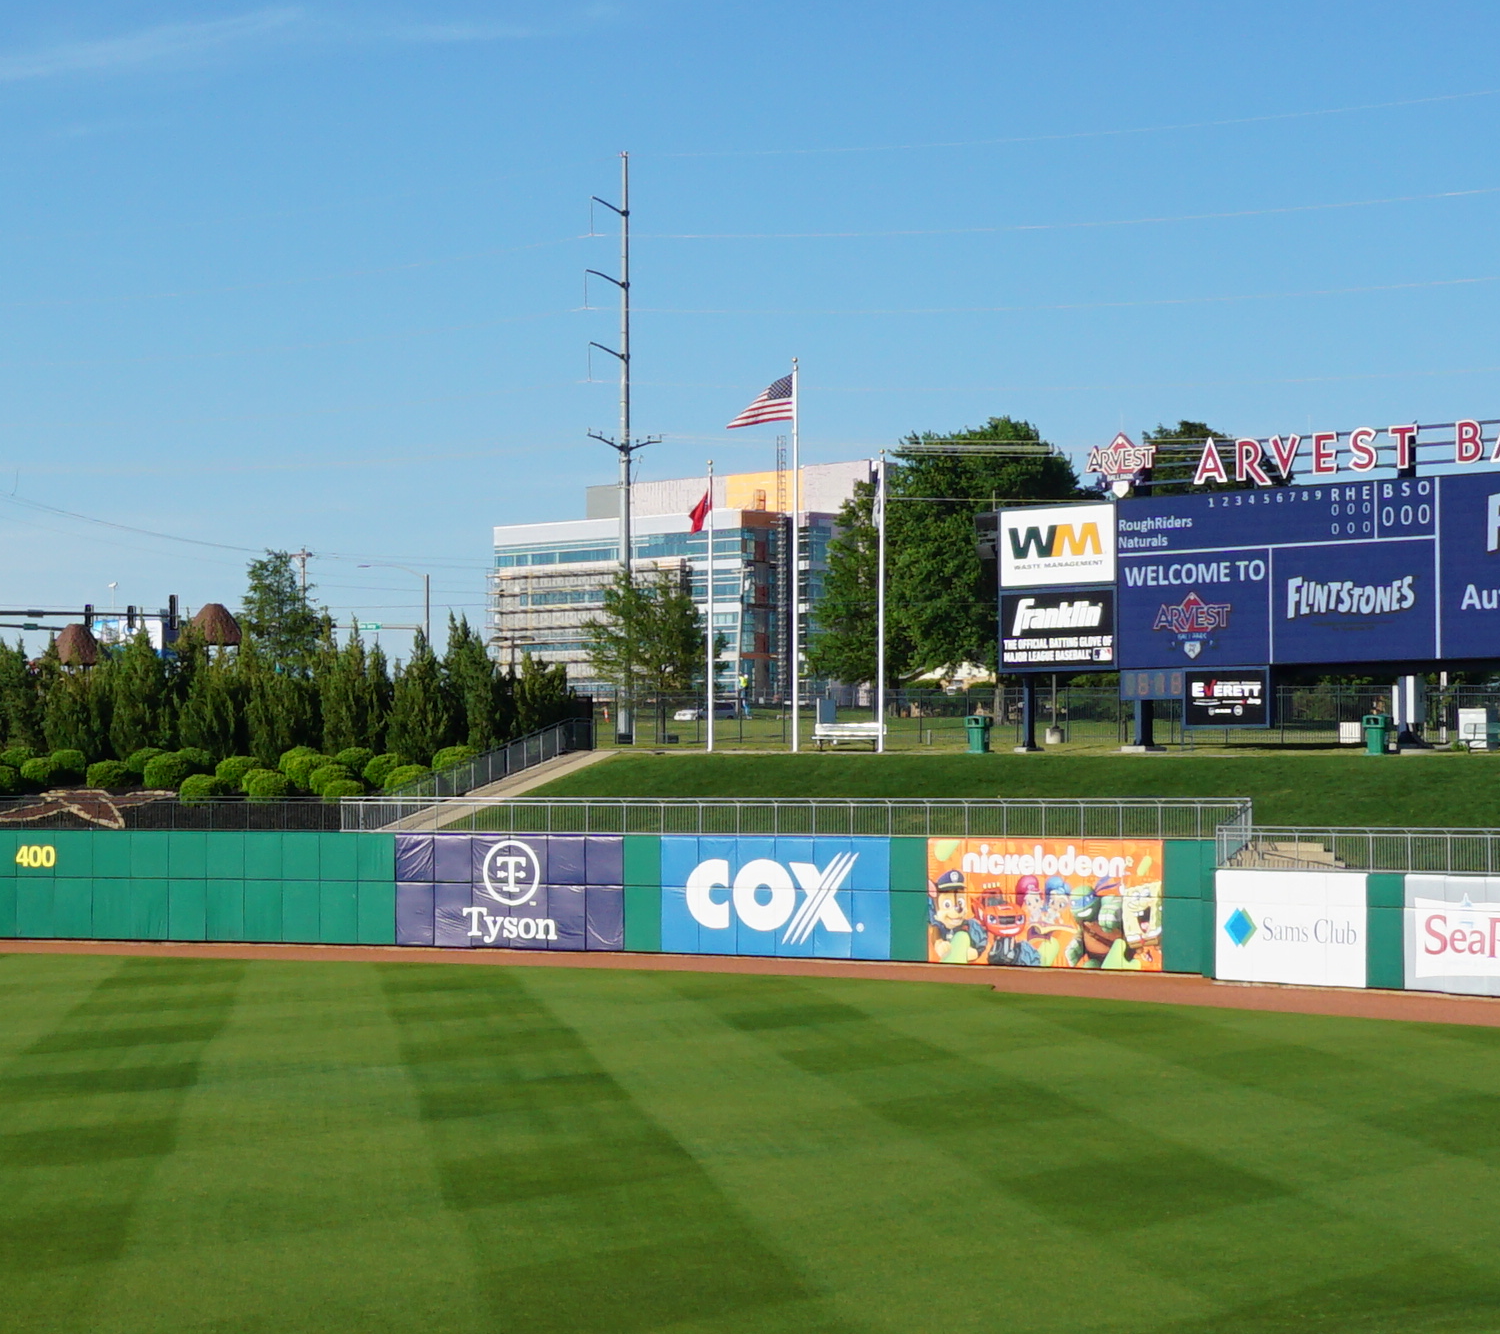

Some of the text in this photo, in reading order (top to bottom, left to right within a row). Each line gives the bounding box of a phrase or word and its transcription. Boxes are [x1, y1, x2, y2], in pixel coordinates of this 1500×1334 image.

[1086, 444, 1157, 474] ARVEST
[1193, 423, 1418, 486] ARVEST
[1208, 486, 1371, 508] 1 2 3 4 5 6 7 8 9 R H E
[1383, 481, 1430, 498] B S O
[1331, 502, 1370, 516] 0 0 0
[1382, 504, 1430, 527] 0 0 0
[1118, 516, 1193, 533] RoughRiders
[1331, 521, 1370, 534] 0 0 0
[1008, 522, 1103, 560] WM
[1118, 534, 1168, 549] Naturals
[1014, 560, 1103, 571] WASTE MANAGEMENT
[1124, 559, 1265, 587] WELCOME TO
[1287, 575, 1415, 619] FLINTSTONES
[1153, 603, 1231, 633] ARVEST
[1003, 635, 1113, 650] THE OFFICIAL BATTING GLOVE OF
[1003, 651, 1027, 662] MAJOR
[1028, 650, 1054, 662] LEAGUE
[1191, 679, 1262, 698] EVERETT
[15, 845, 56, 868] 400
[962, 844, 1126, 878] nickelodeon
[686, 851, 860, 945] COX
[462, 906, 558, 943] Tyson
[1262, 916, 1358, 946] Sams Club
